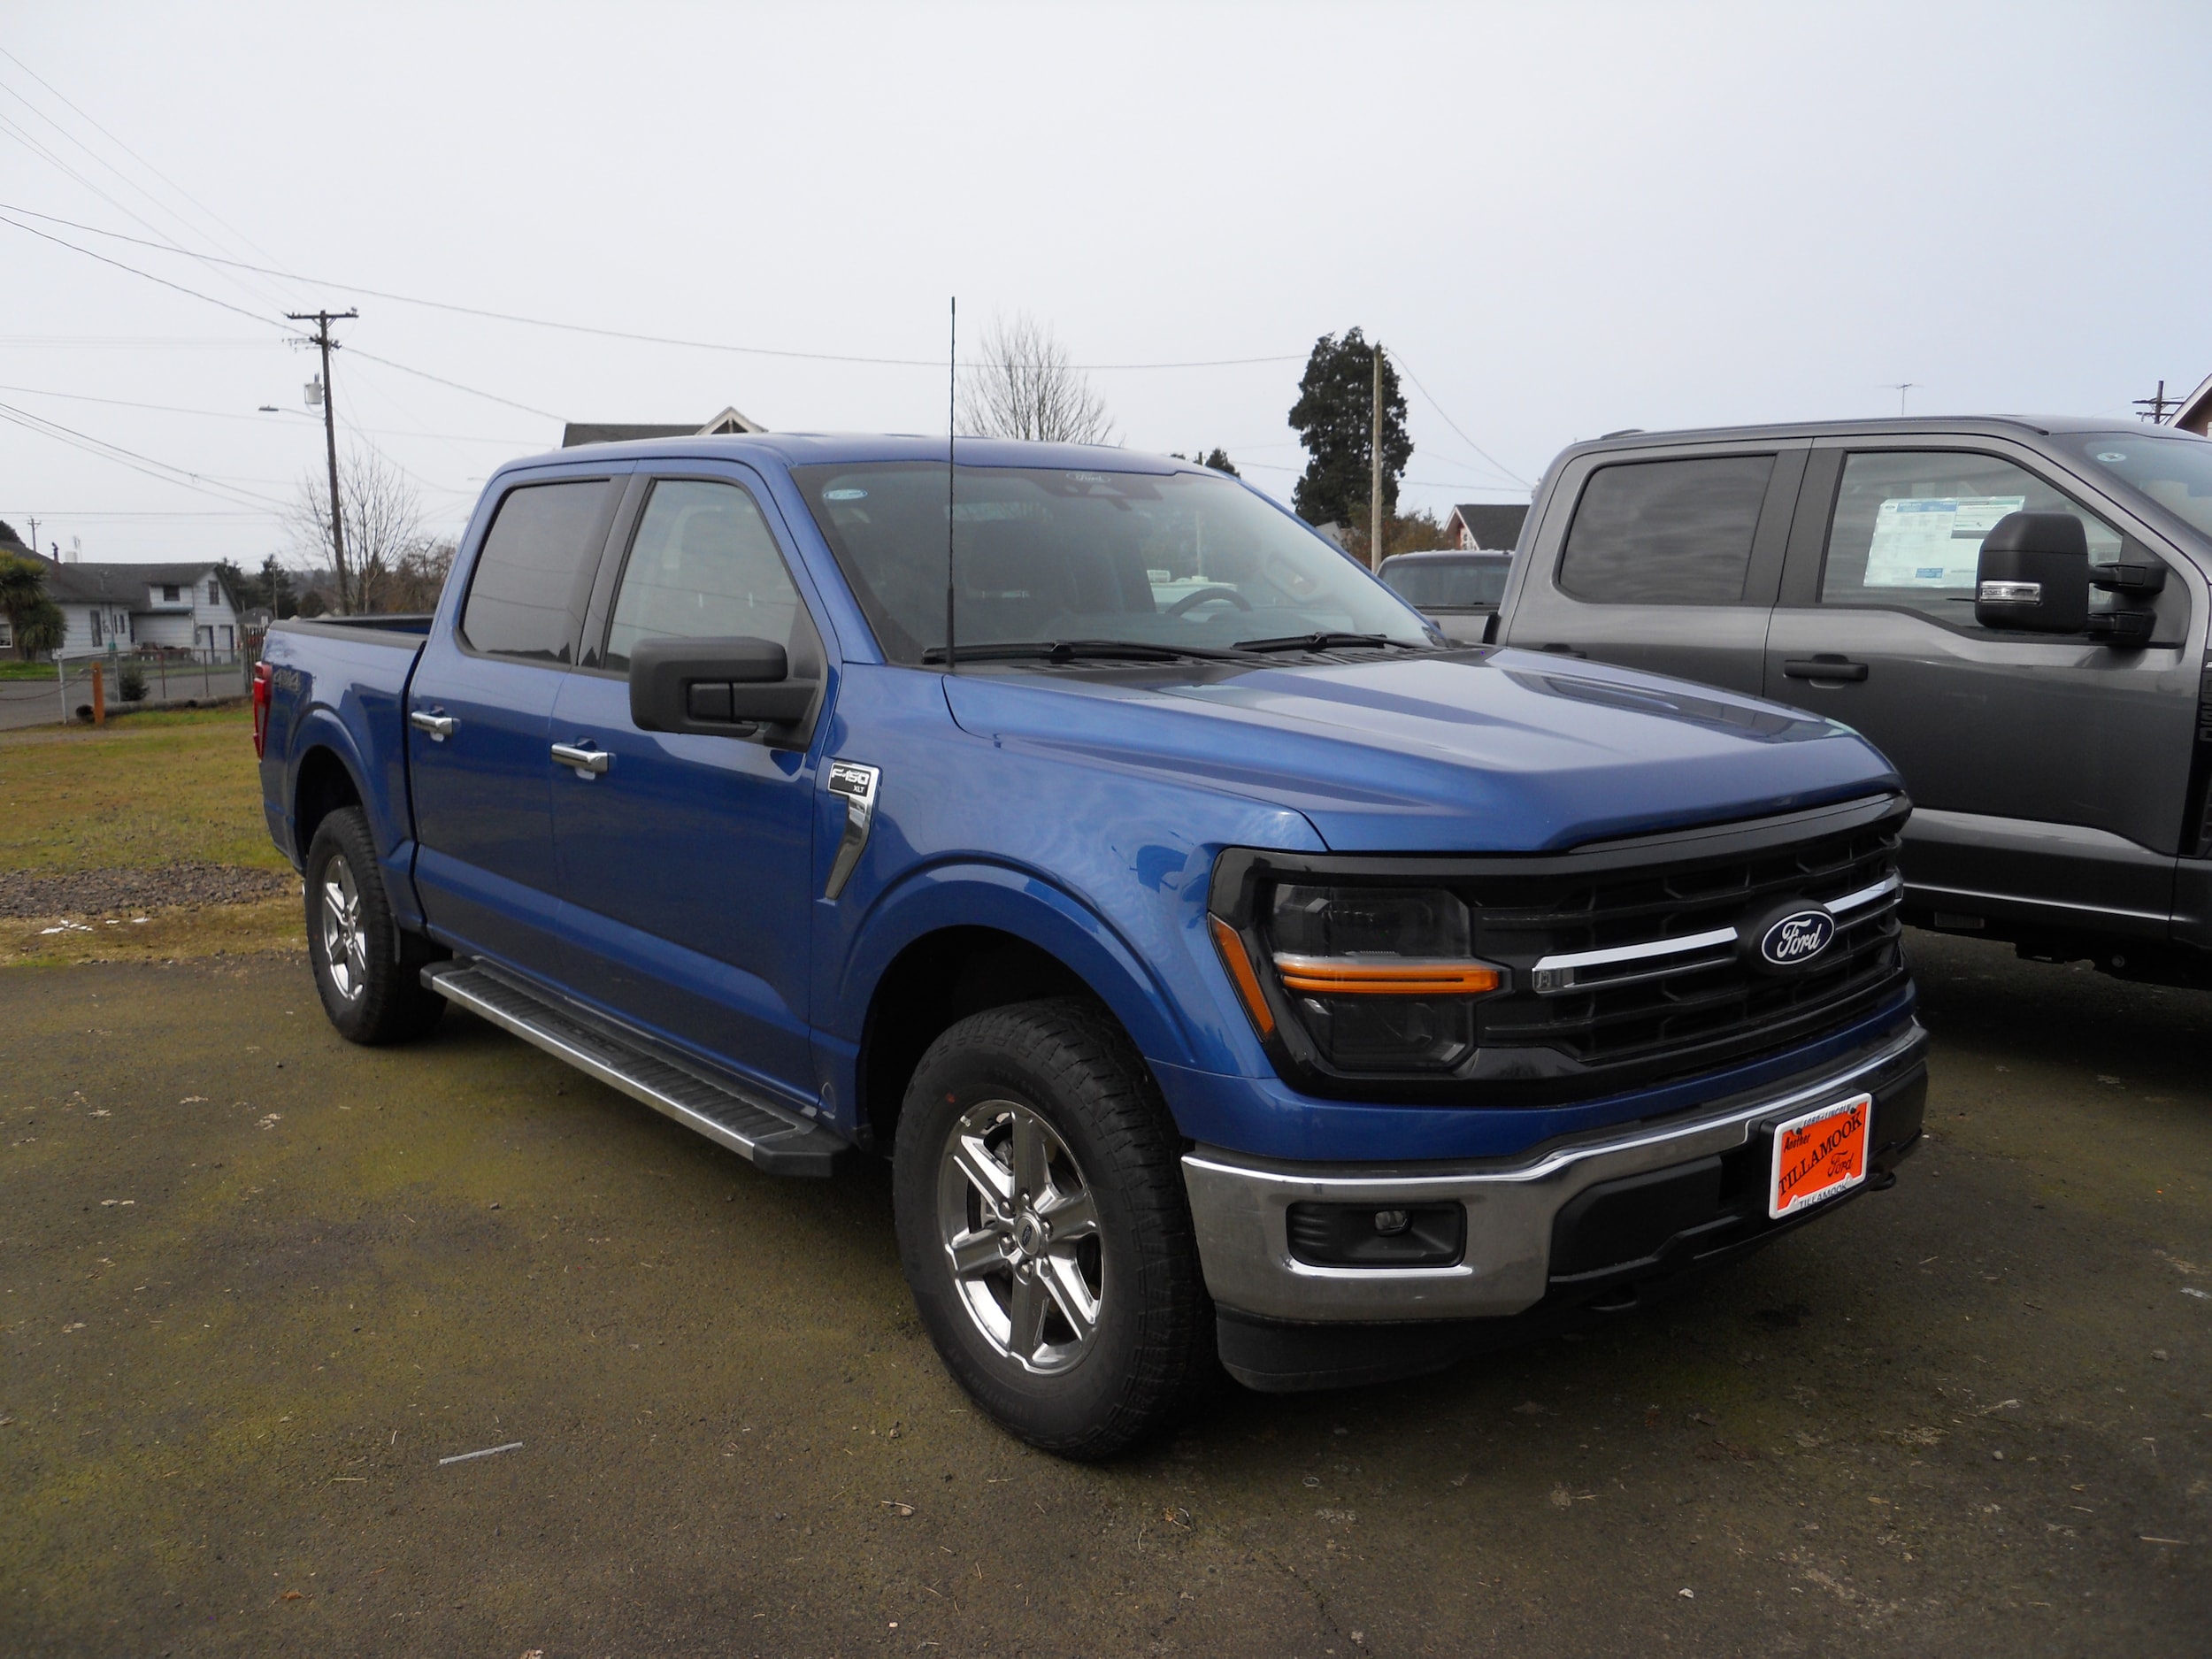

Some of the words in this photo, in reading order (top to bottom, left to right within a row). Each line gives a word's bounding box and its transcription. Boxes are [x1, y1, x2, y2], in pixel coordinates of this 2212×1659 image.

[831, 768, 870, 785] F-150
[1776, 918, 1822, 958] Ford
[1778, 1110, 1862, 1195] TILLAMOOK
[1784, 1133, 1810, 1153] Another
[1827, 1150, 1855, 1178] Ford
[1800, 1182, 1847, 1208] TILLAMOOK
